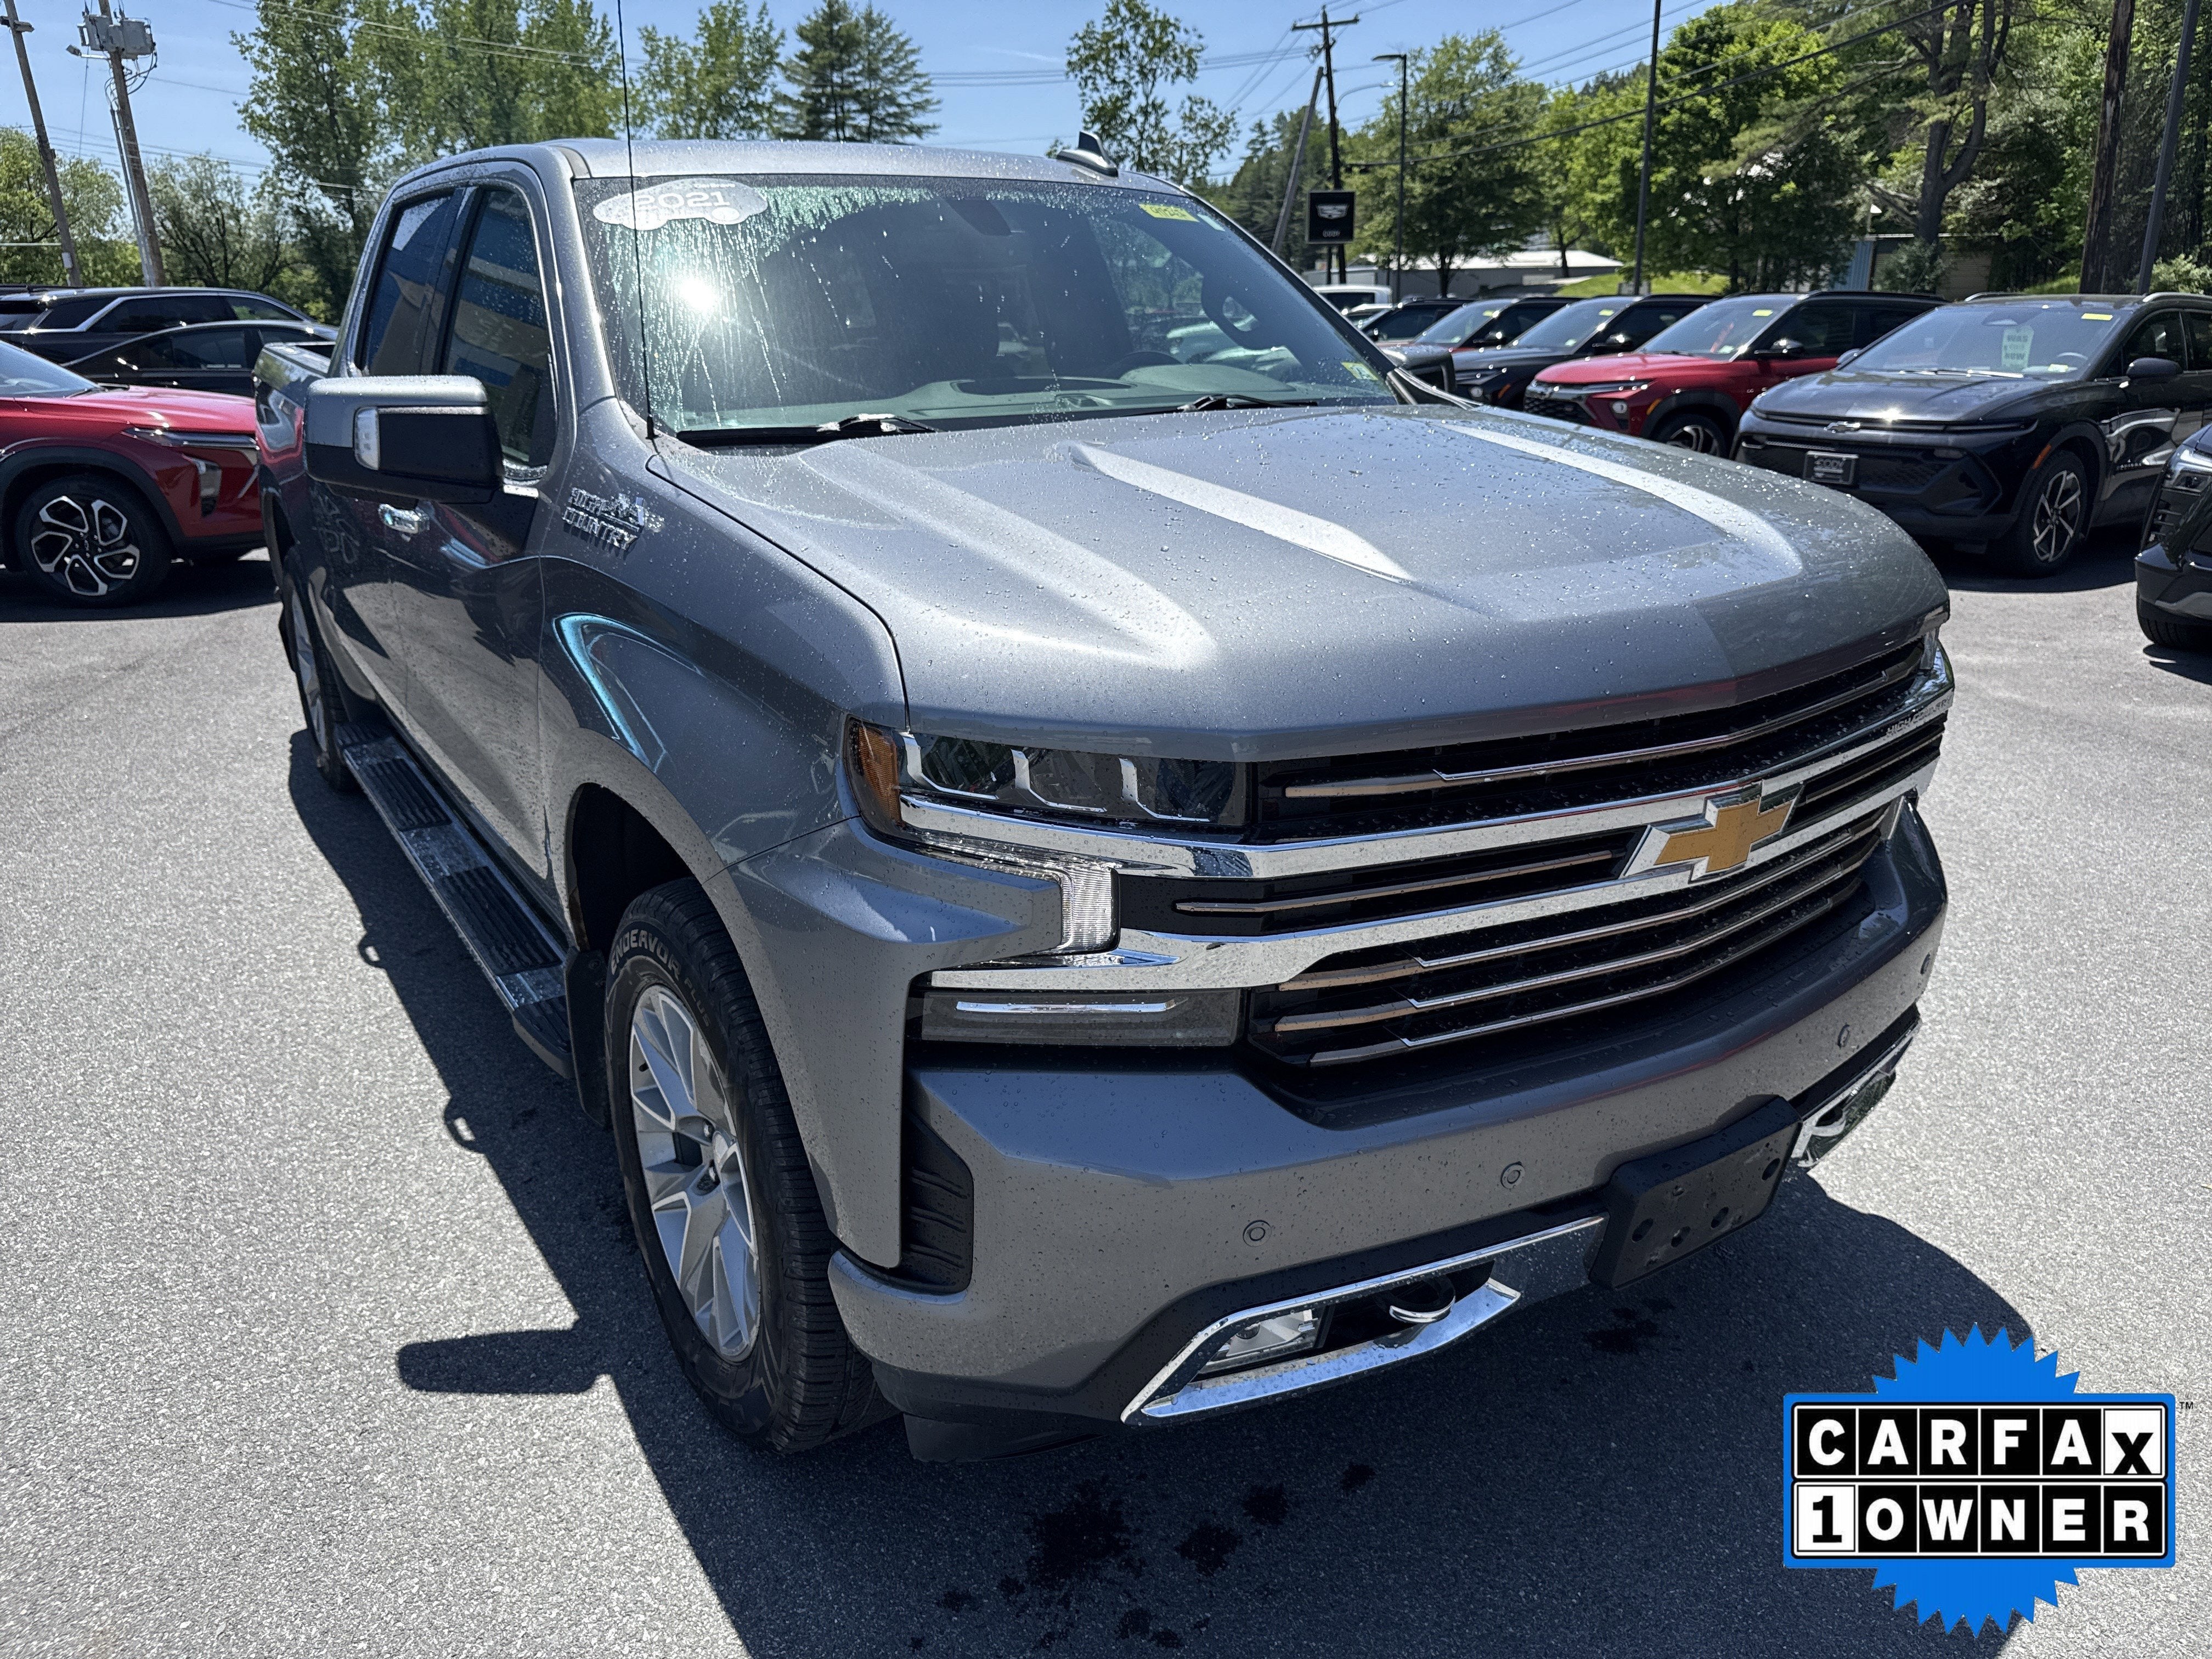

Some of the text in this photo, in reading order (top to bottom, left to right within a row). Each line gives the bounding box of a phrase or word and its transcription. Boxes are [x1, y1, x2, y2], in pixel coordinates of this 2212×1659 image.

[633, 191, 730, 210] 2021
[561, 506, 638, 550] COUNTRY
[611, 928, 681, 981] ENDEAVOR
